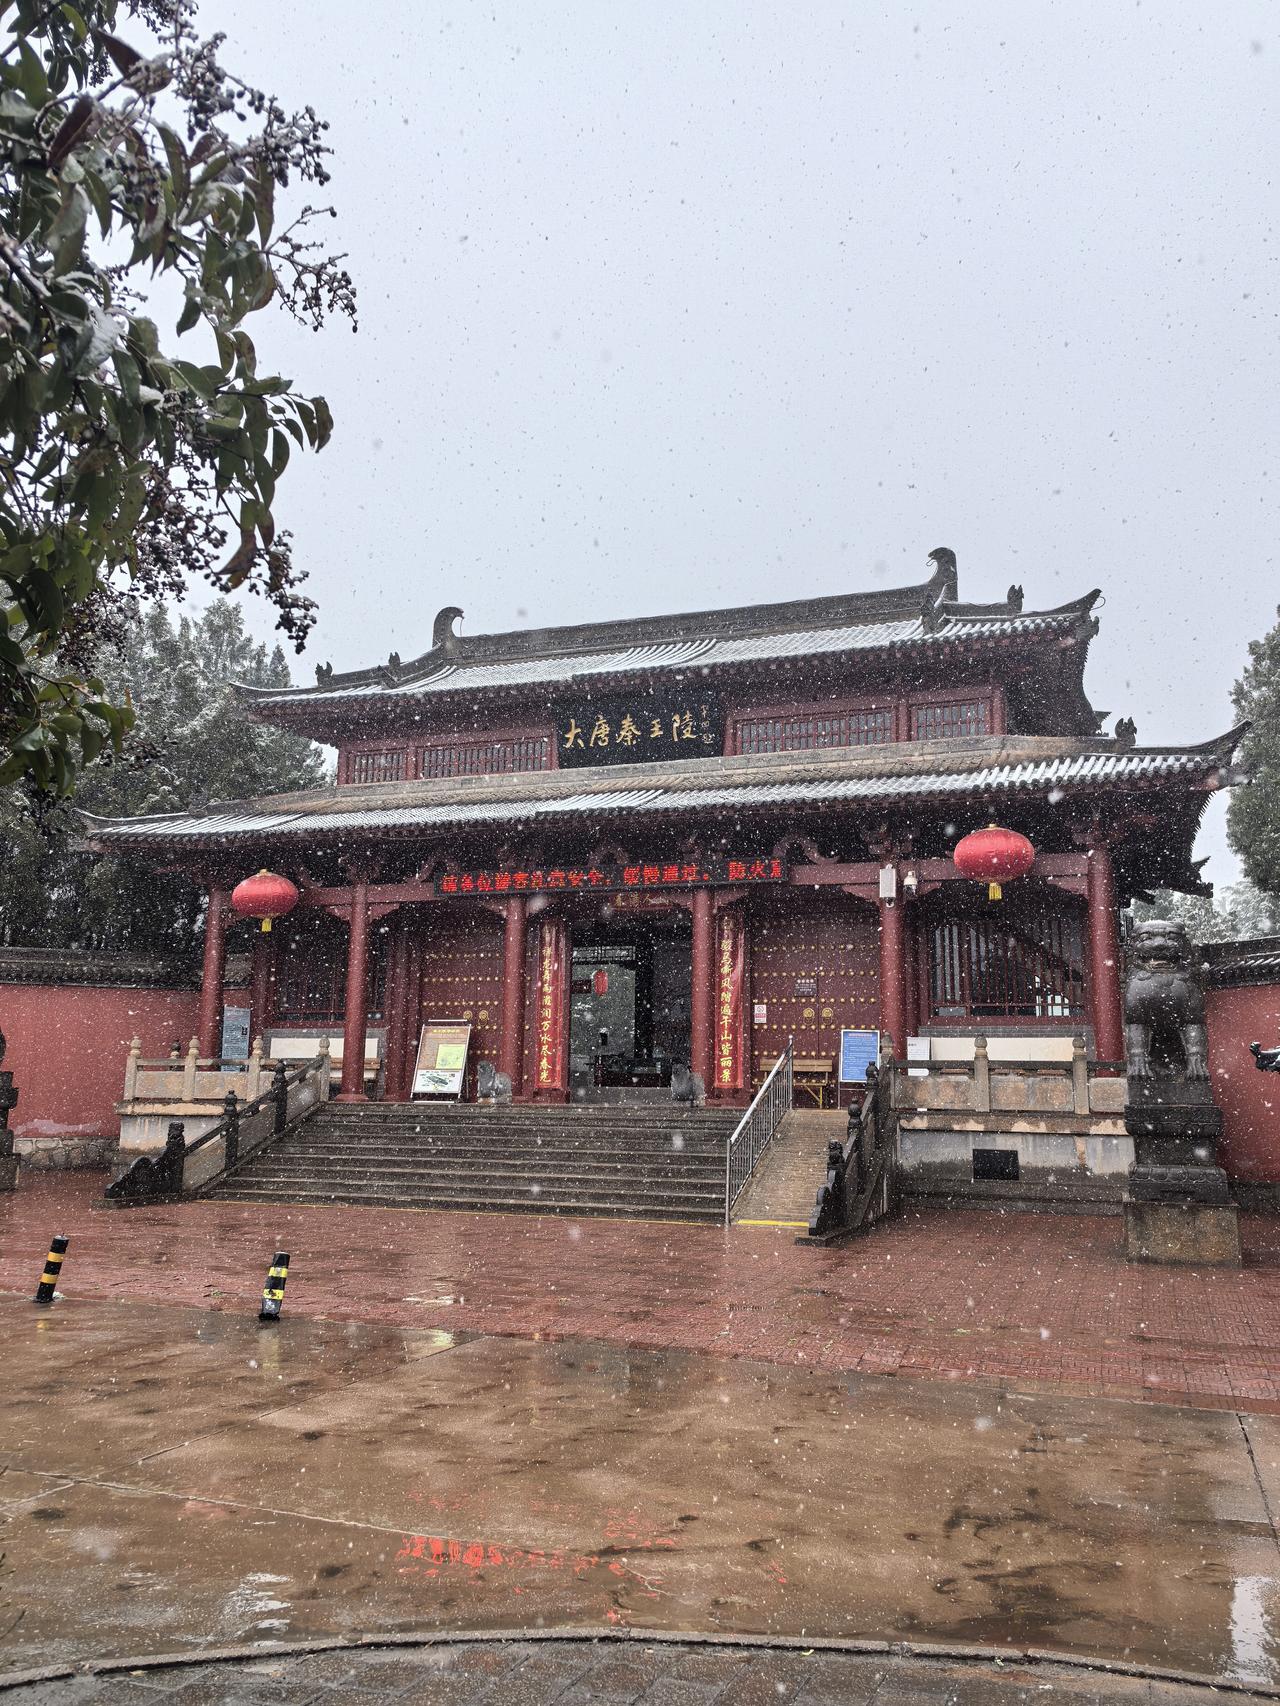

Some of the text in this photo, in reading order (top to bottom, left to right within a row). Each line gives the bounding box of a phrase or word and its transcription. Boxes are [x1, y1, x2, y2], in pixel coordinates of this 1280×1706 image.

[562, 710, 697, 750] 大唐秦王陵
